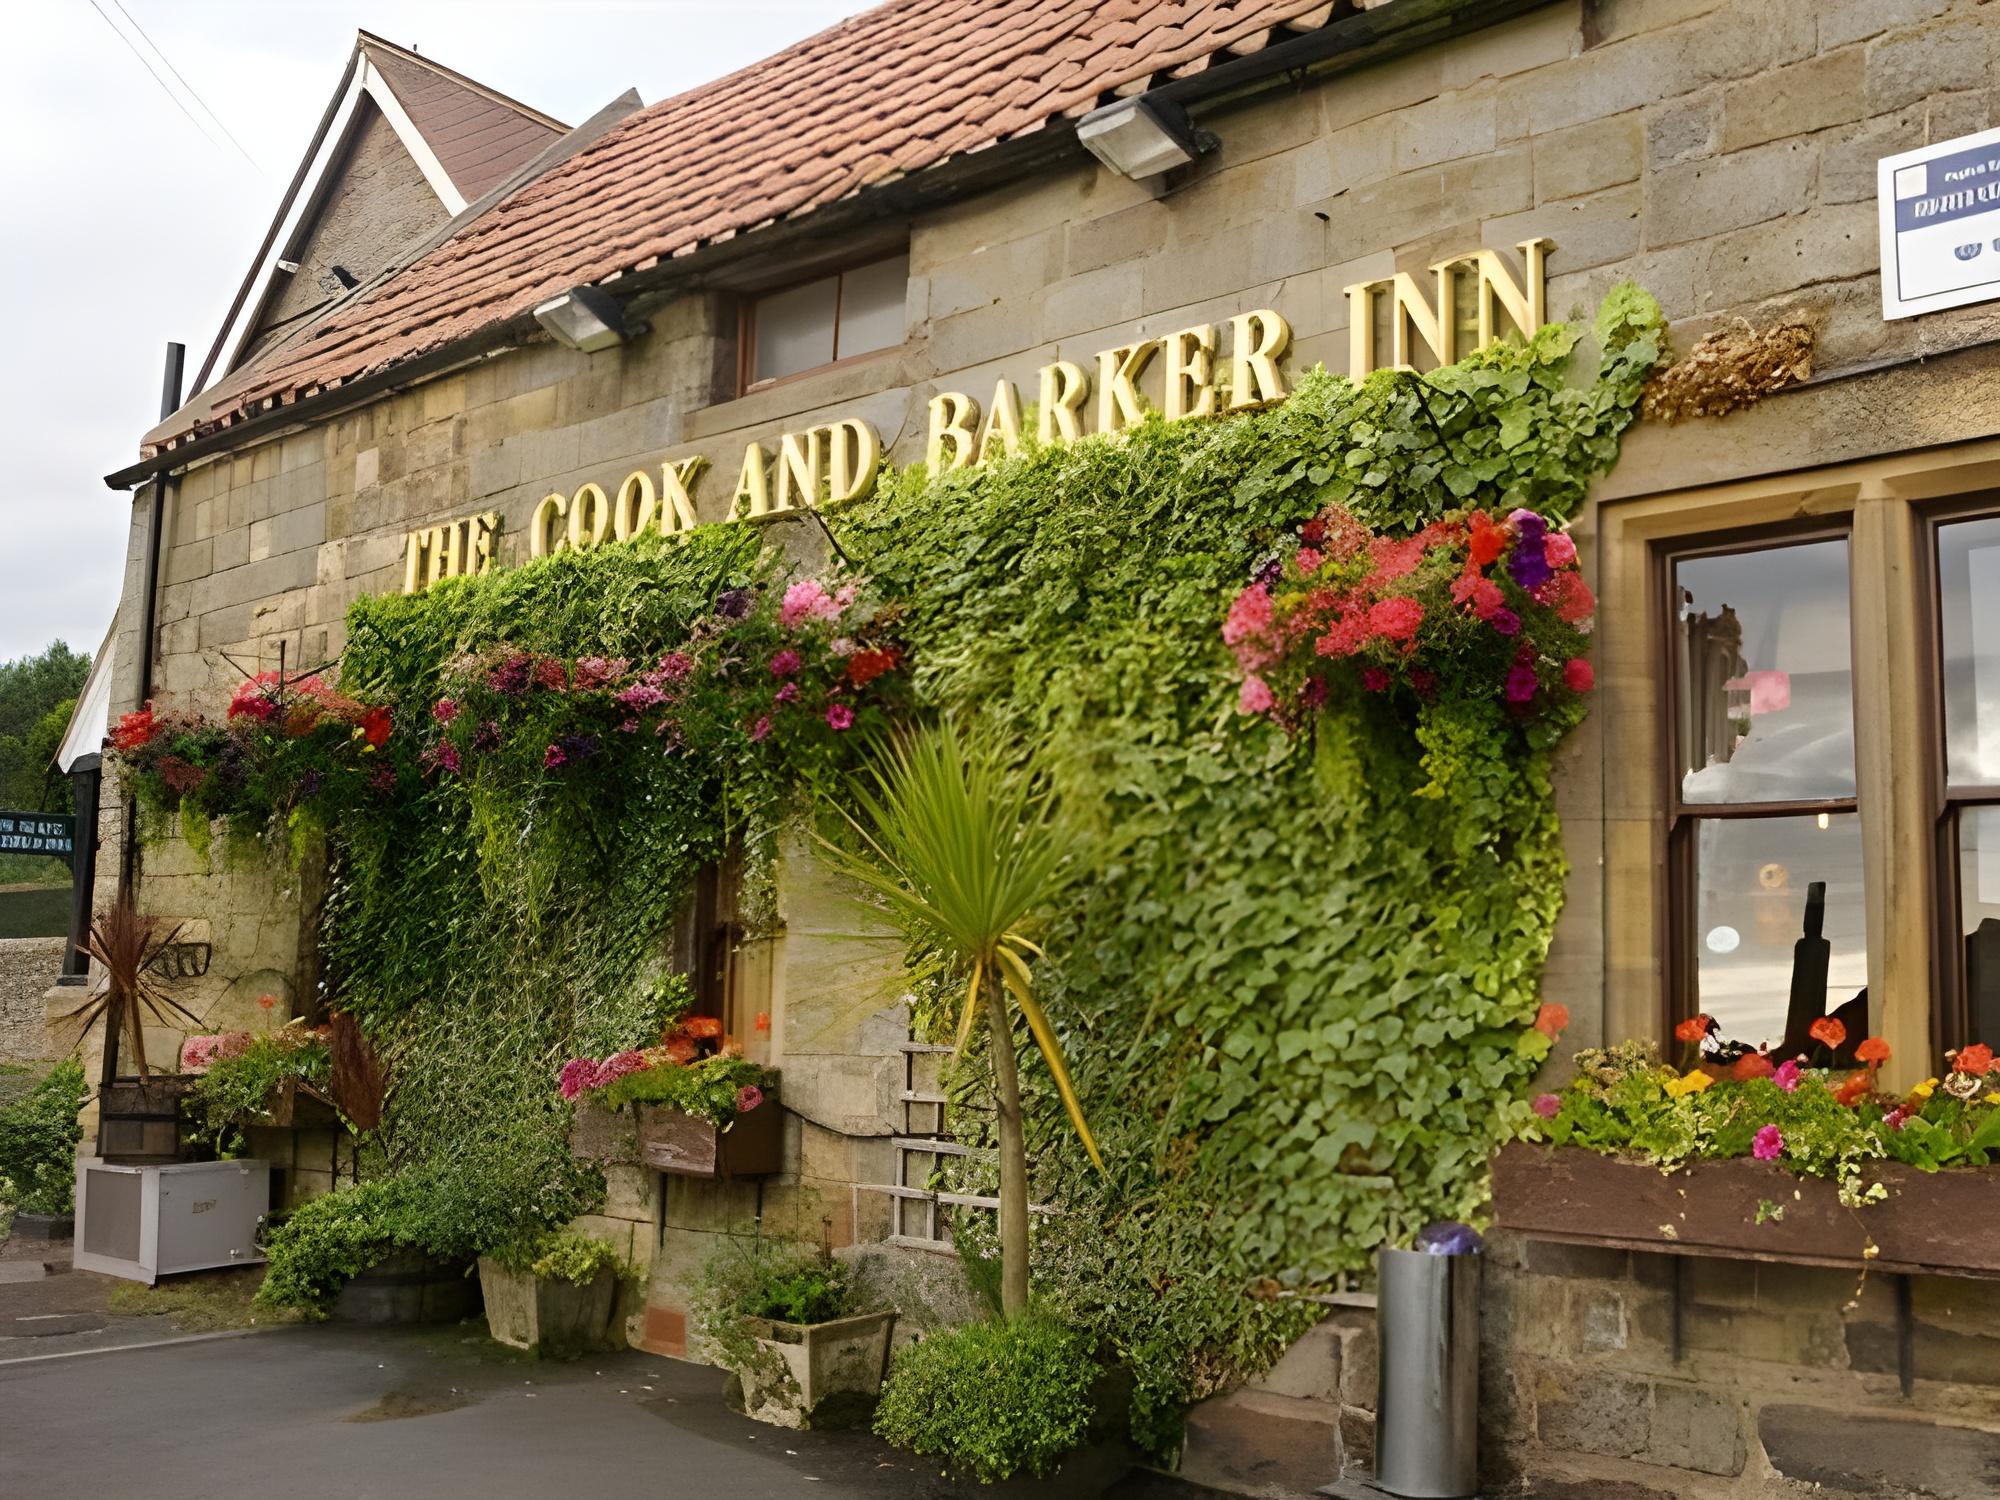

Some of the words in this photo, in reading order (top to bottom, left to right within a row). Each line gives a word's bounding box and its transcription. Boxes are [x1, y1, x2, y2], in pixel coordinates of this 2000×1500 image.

[404, 513, 501, 593] THE
[531, 457, 710, 557] COOK
[726, 418, 880, 523] AND
[926, 310, 1291, 478] BARKER
[1345, 238, 1556, 385] INN
